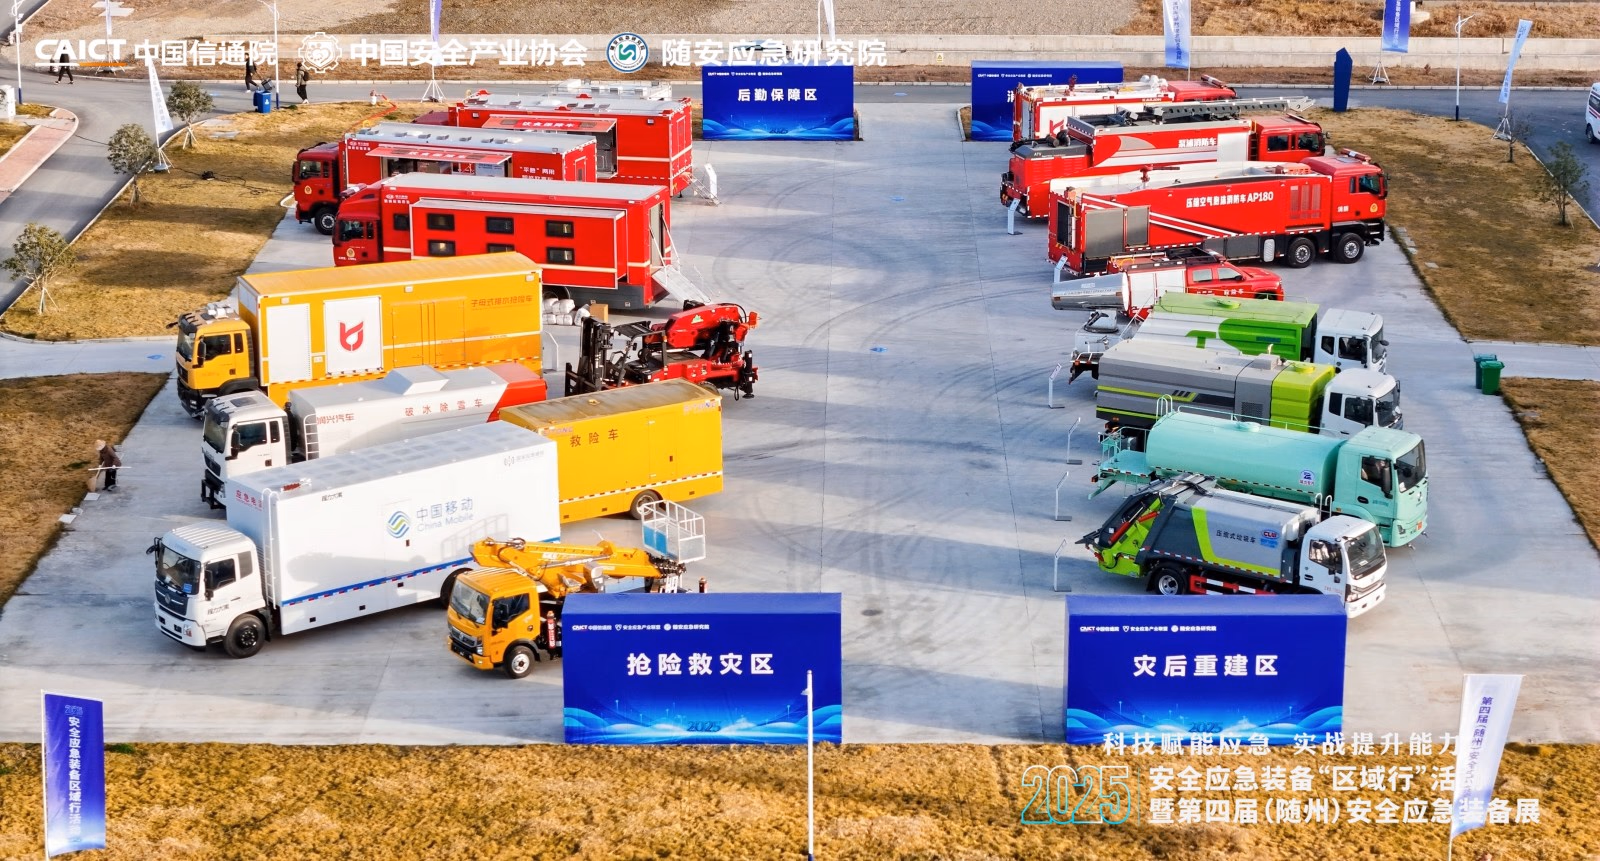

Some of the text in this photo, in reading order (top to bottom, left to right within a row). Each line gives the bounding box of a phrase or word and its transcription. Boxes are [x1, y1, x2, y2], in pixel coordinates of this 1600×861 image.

[737, 88, 817, 103] 后勤保障区
[1246, 190, 1274, 204] AP180
[404, 397, 484, 418] 破冰除雪车
[569, 427, 620, 448] 救险车
[416, 496, 474, 522] 中国移动
[416, 512, 475, 533] China Mobile
[627, 652, 774, 676] 抢险救灾区
[1132, 653, 1279, 678] 灾后重建区
